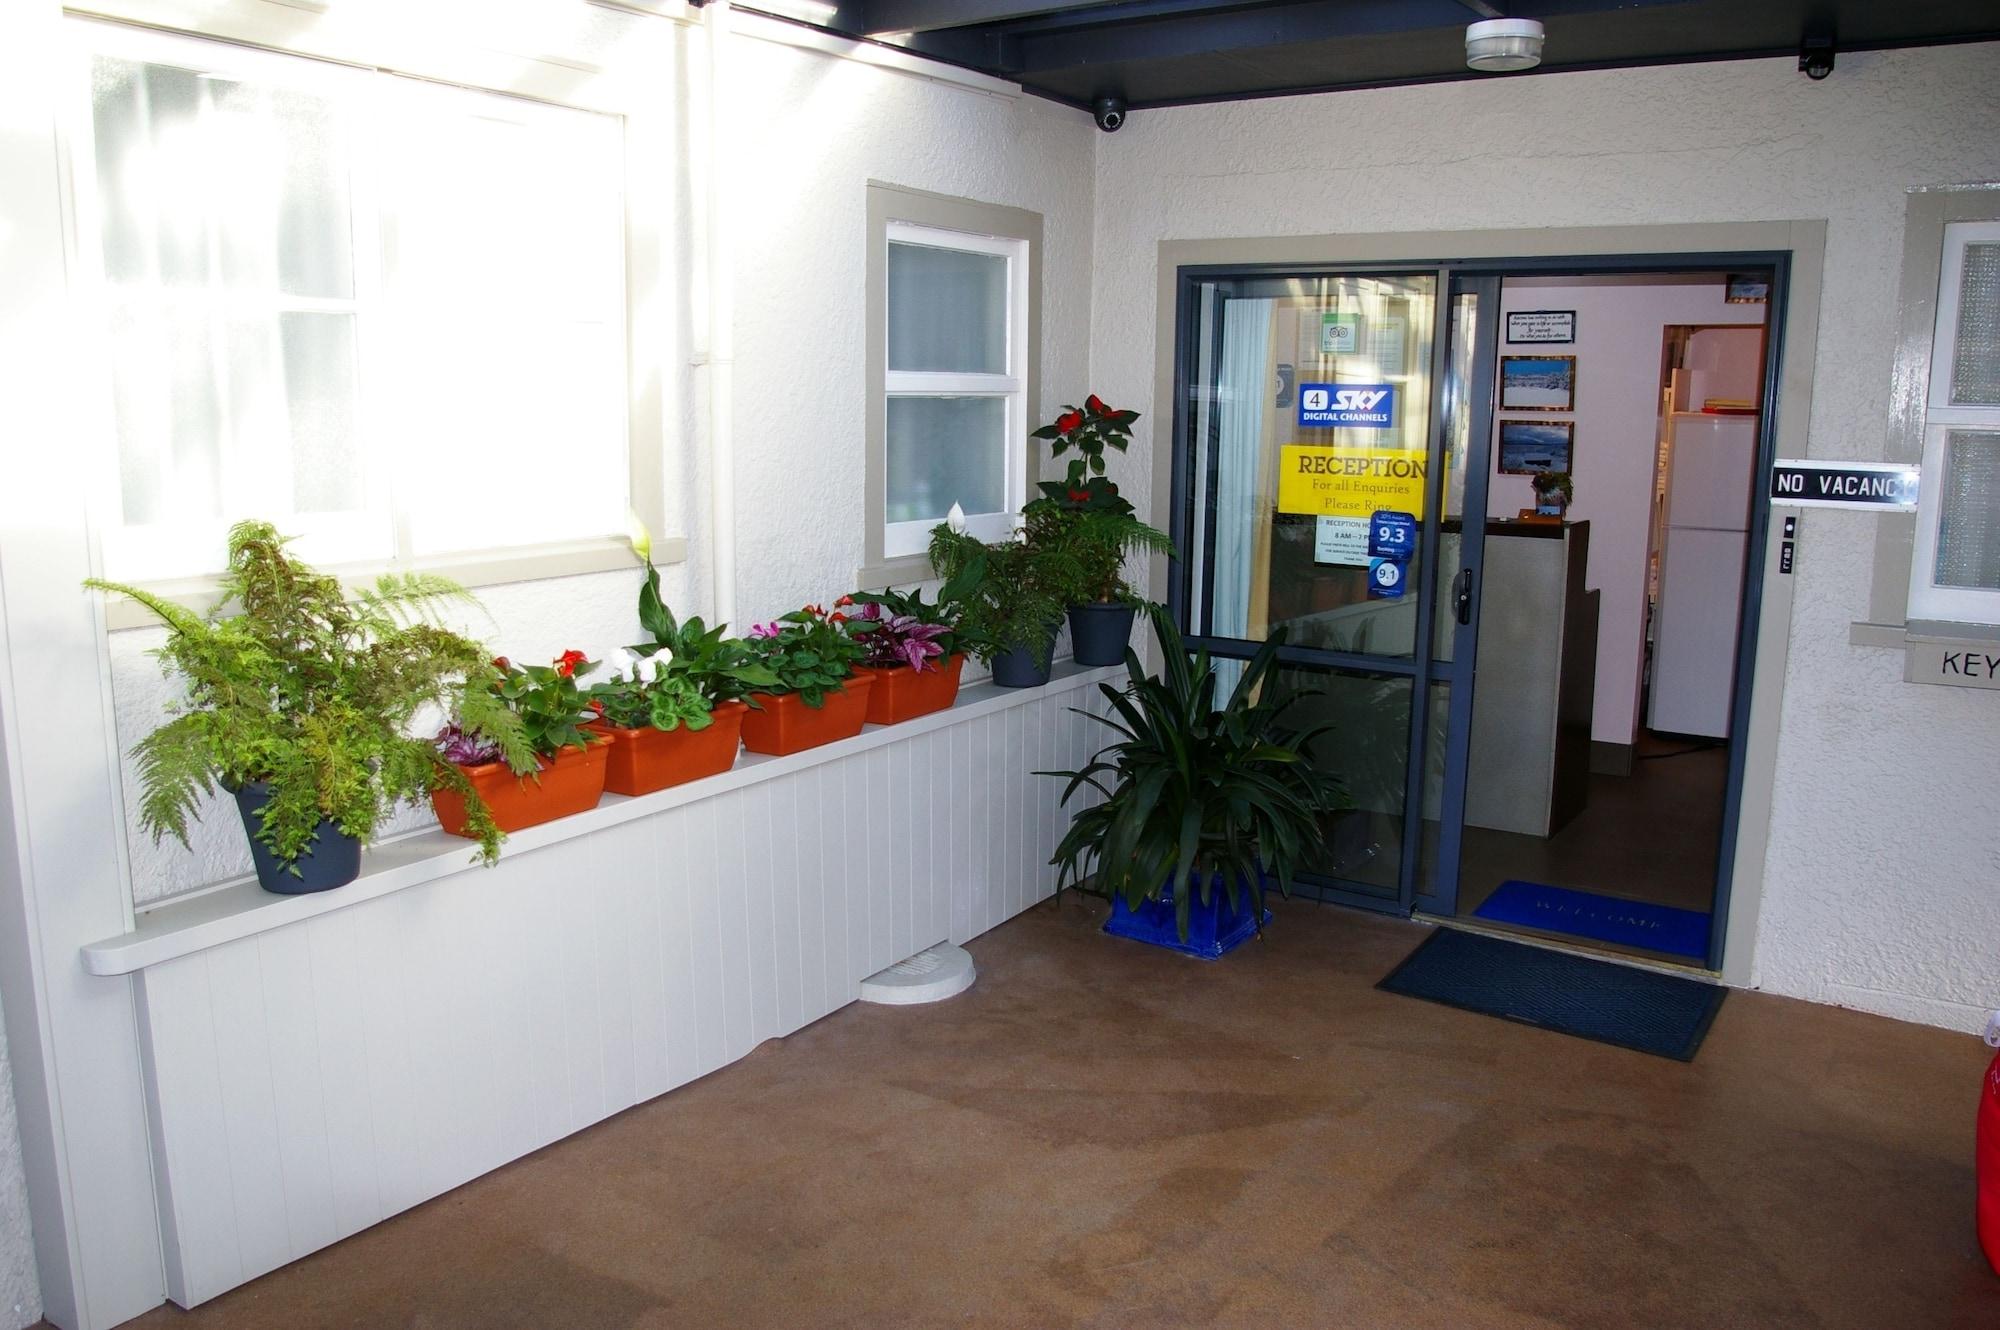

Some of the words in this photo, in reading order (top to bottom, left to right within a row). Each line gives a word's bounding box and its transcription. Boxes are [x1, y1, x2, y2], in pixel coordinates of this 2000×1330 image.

[1309, 392, 1321, 408] 4
[1331, 390, 1389, 411] SKY
[1303, 412, 1338, 422] DIGITAL
[1340, 413, 1388, 423] CHANNELS
[1298, 455, 1429, 479] RECEPTION
[1312, 478, 1331, 490] For
[1335, 480, 1349, 491] all
[1353, 480, 1410, 496] Enquiries
[1777, 473, 1804, 493] NO
[1325, 497, 1360, 510] Please
[1326, 519, 1361, 528] RECEPTION
[1379, 526, 1405, 543] 9.3
[1783, 547, 1792, 570] BELL
[1379, 568, 1395, 580] 9.1
[1942, 651, 2000, 680] KEY
